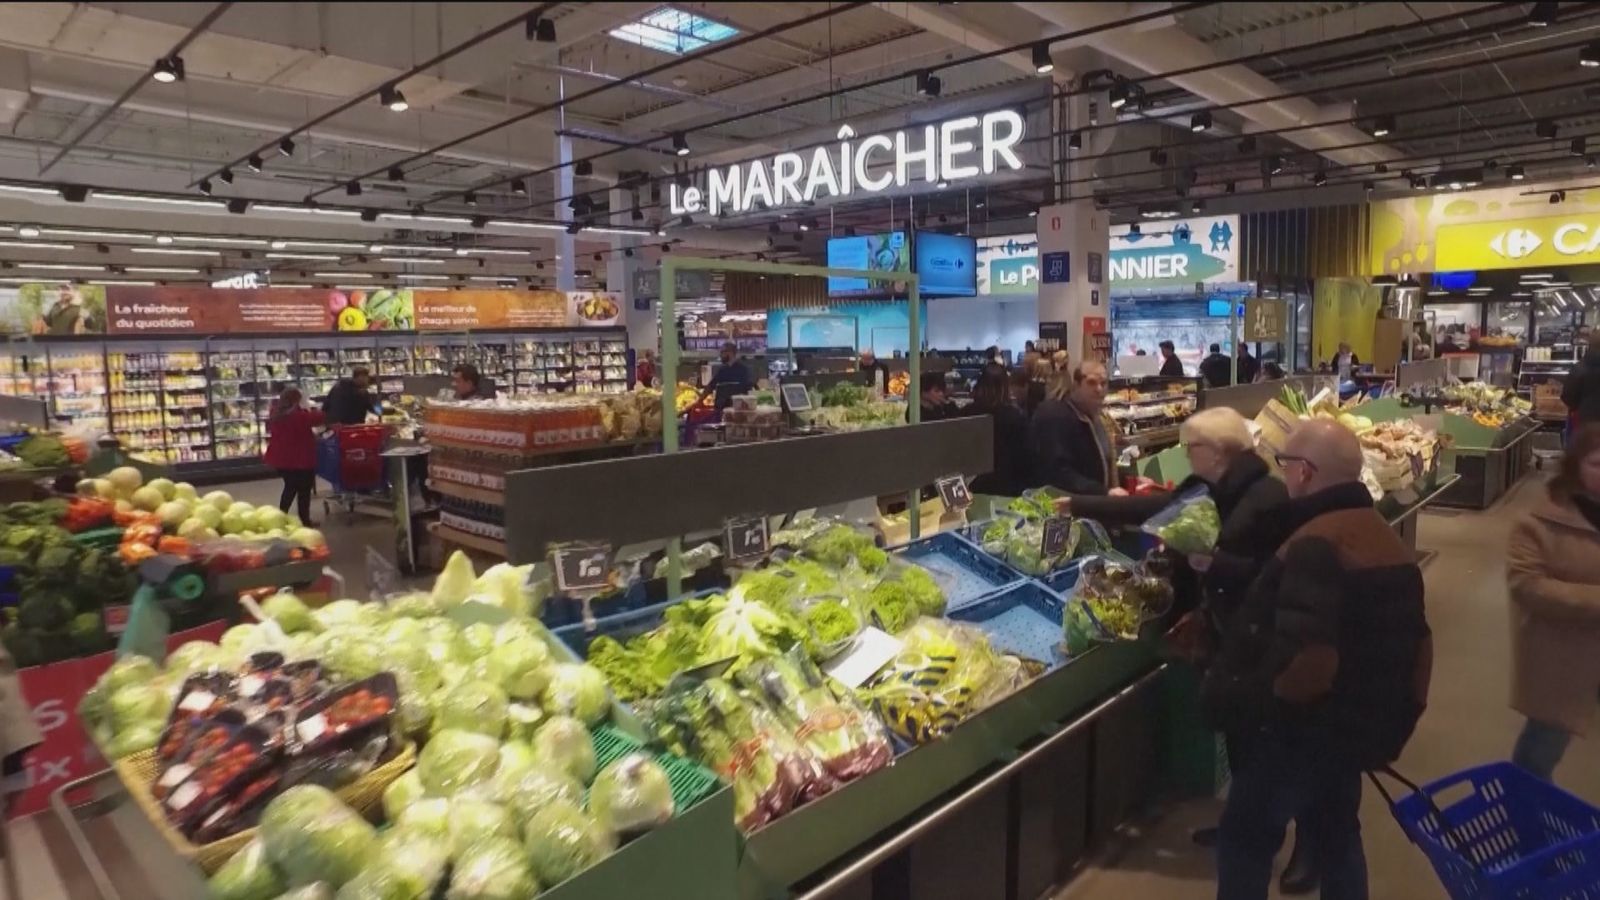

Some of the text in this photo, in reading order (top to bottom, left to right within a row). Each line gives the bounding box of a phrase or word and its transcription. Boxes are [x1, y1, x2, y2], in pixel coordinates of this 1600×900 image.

[669, 110, 1023, 216] Le MARAÎCHER
[1000, 269, 1018, 285] Le
[115, 303, 190, 314] La fraîcheur
[116, 318, 195, 330] du quotidien
